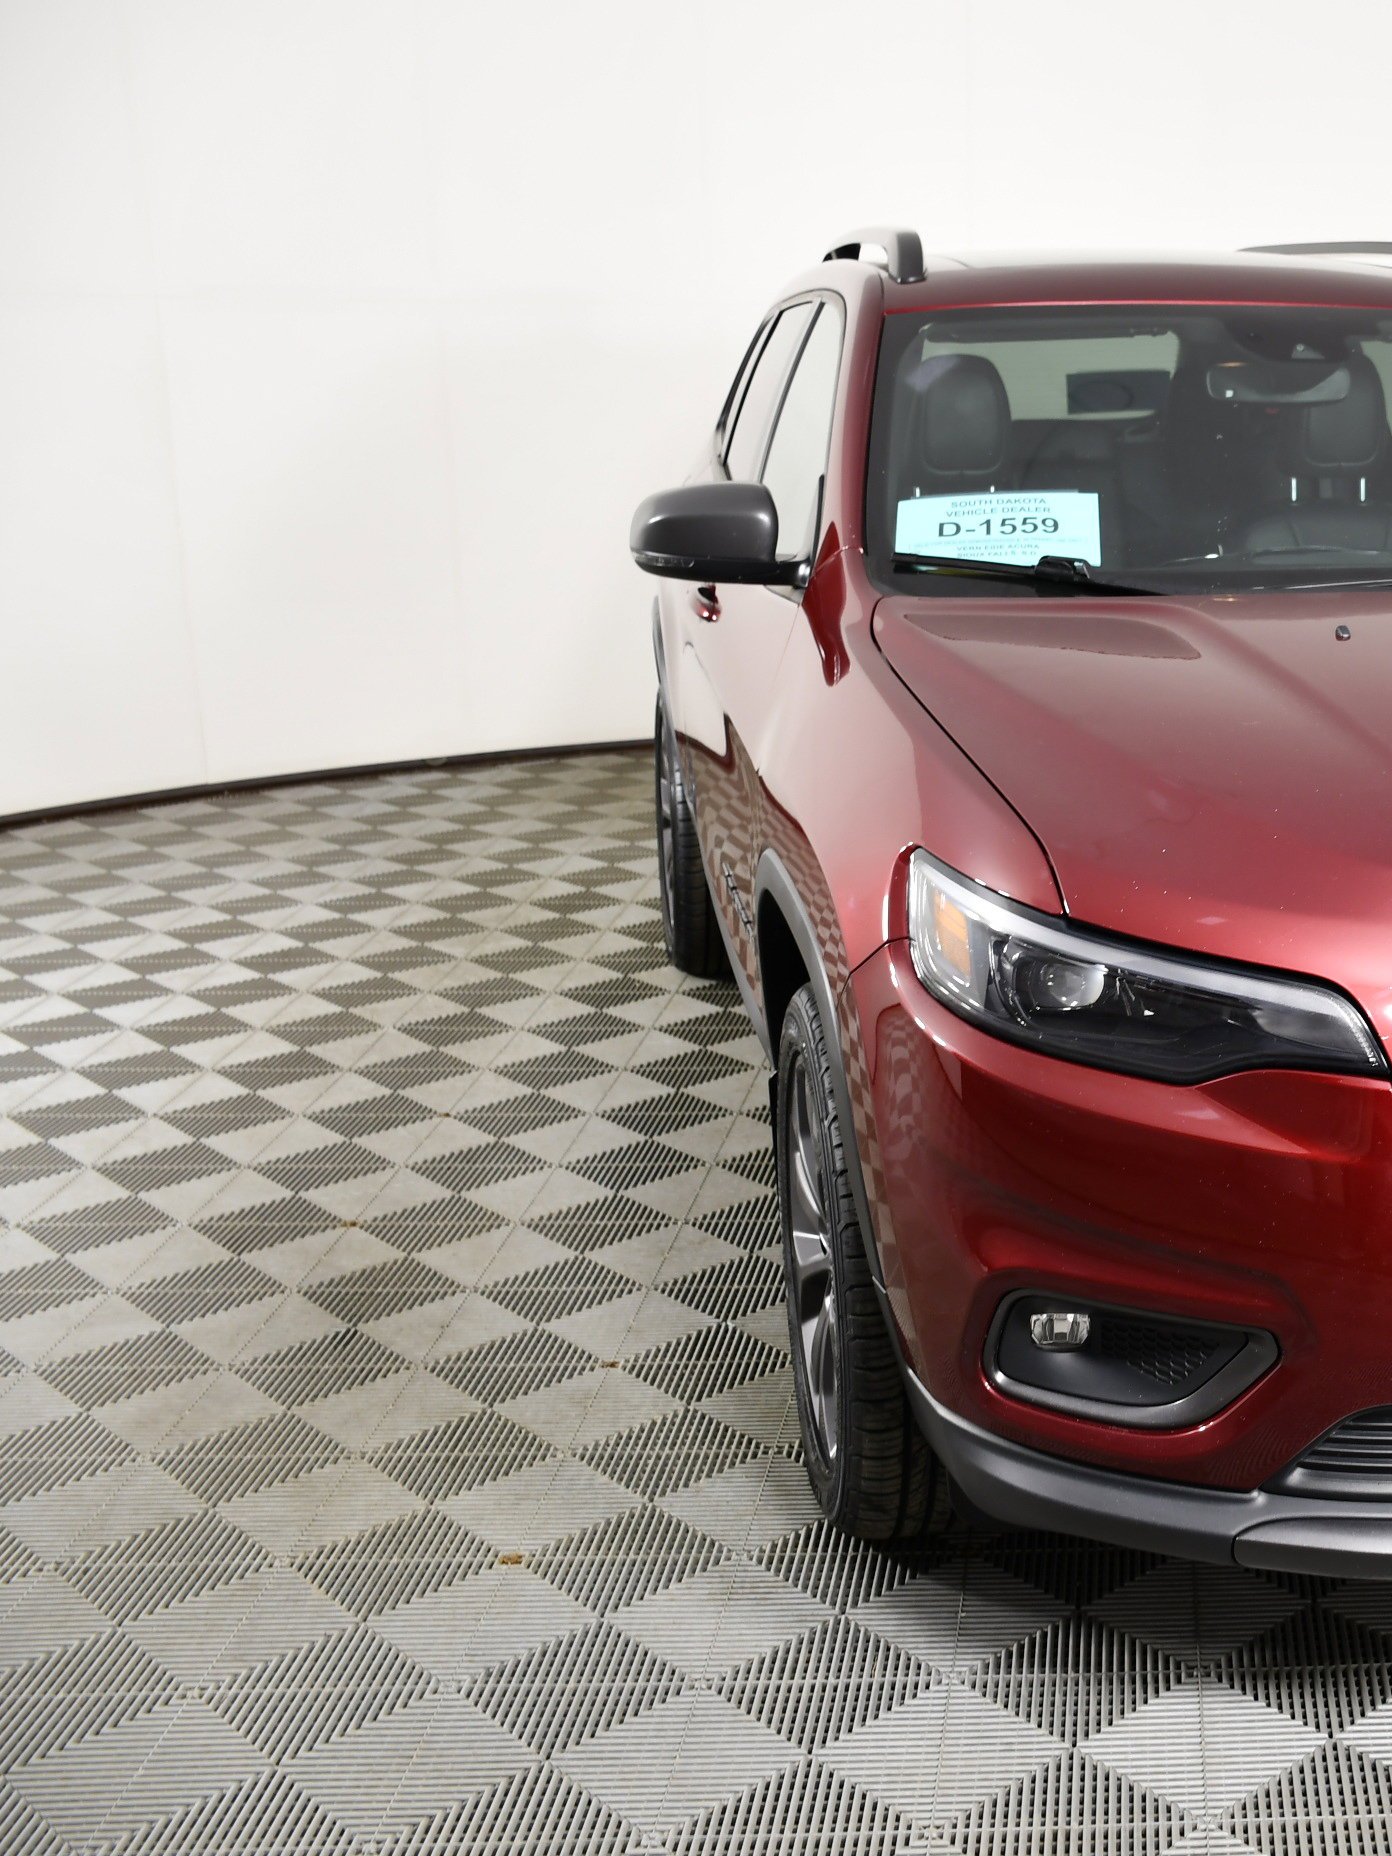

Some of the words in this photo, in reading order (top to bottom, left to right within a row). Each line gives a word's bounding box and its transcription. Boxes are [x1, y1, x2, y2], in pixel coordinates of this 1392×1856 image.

[951, 499, 993, 509] SOUTH
[996, 497, 1047, 506] DAKOTA
[946, 507, 997, 517] VEHICLE
[1002, 506, 1051, 514] DEALER
[938, 516, 1060, 538] D-1559
